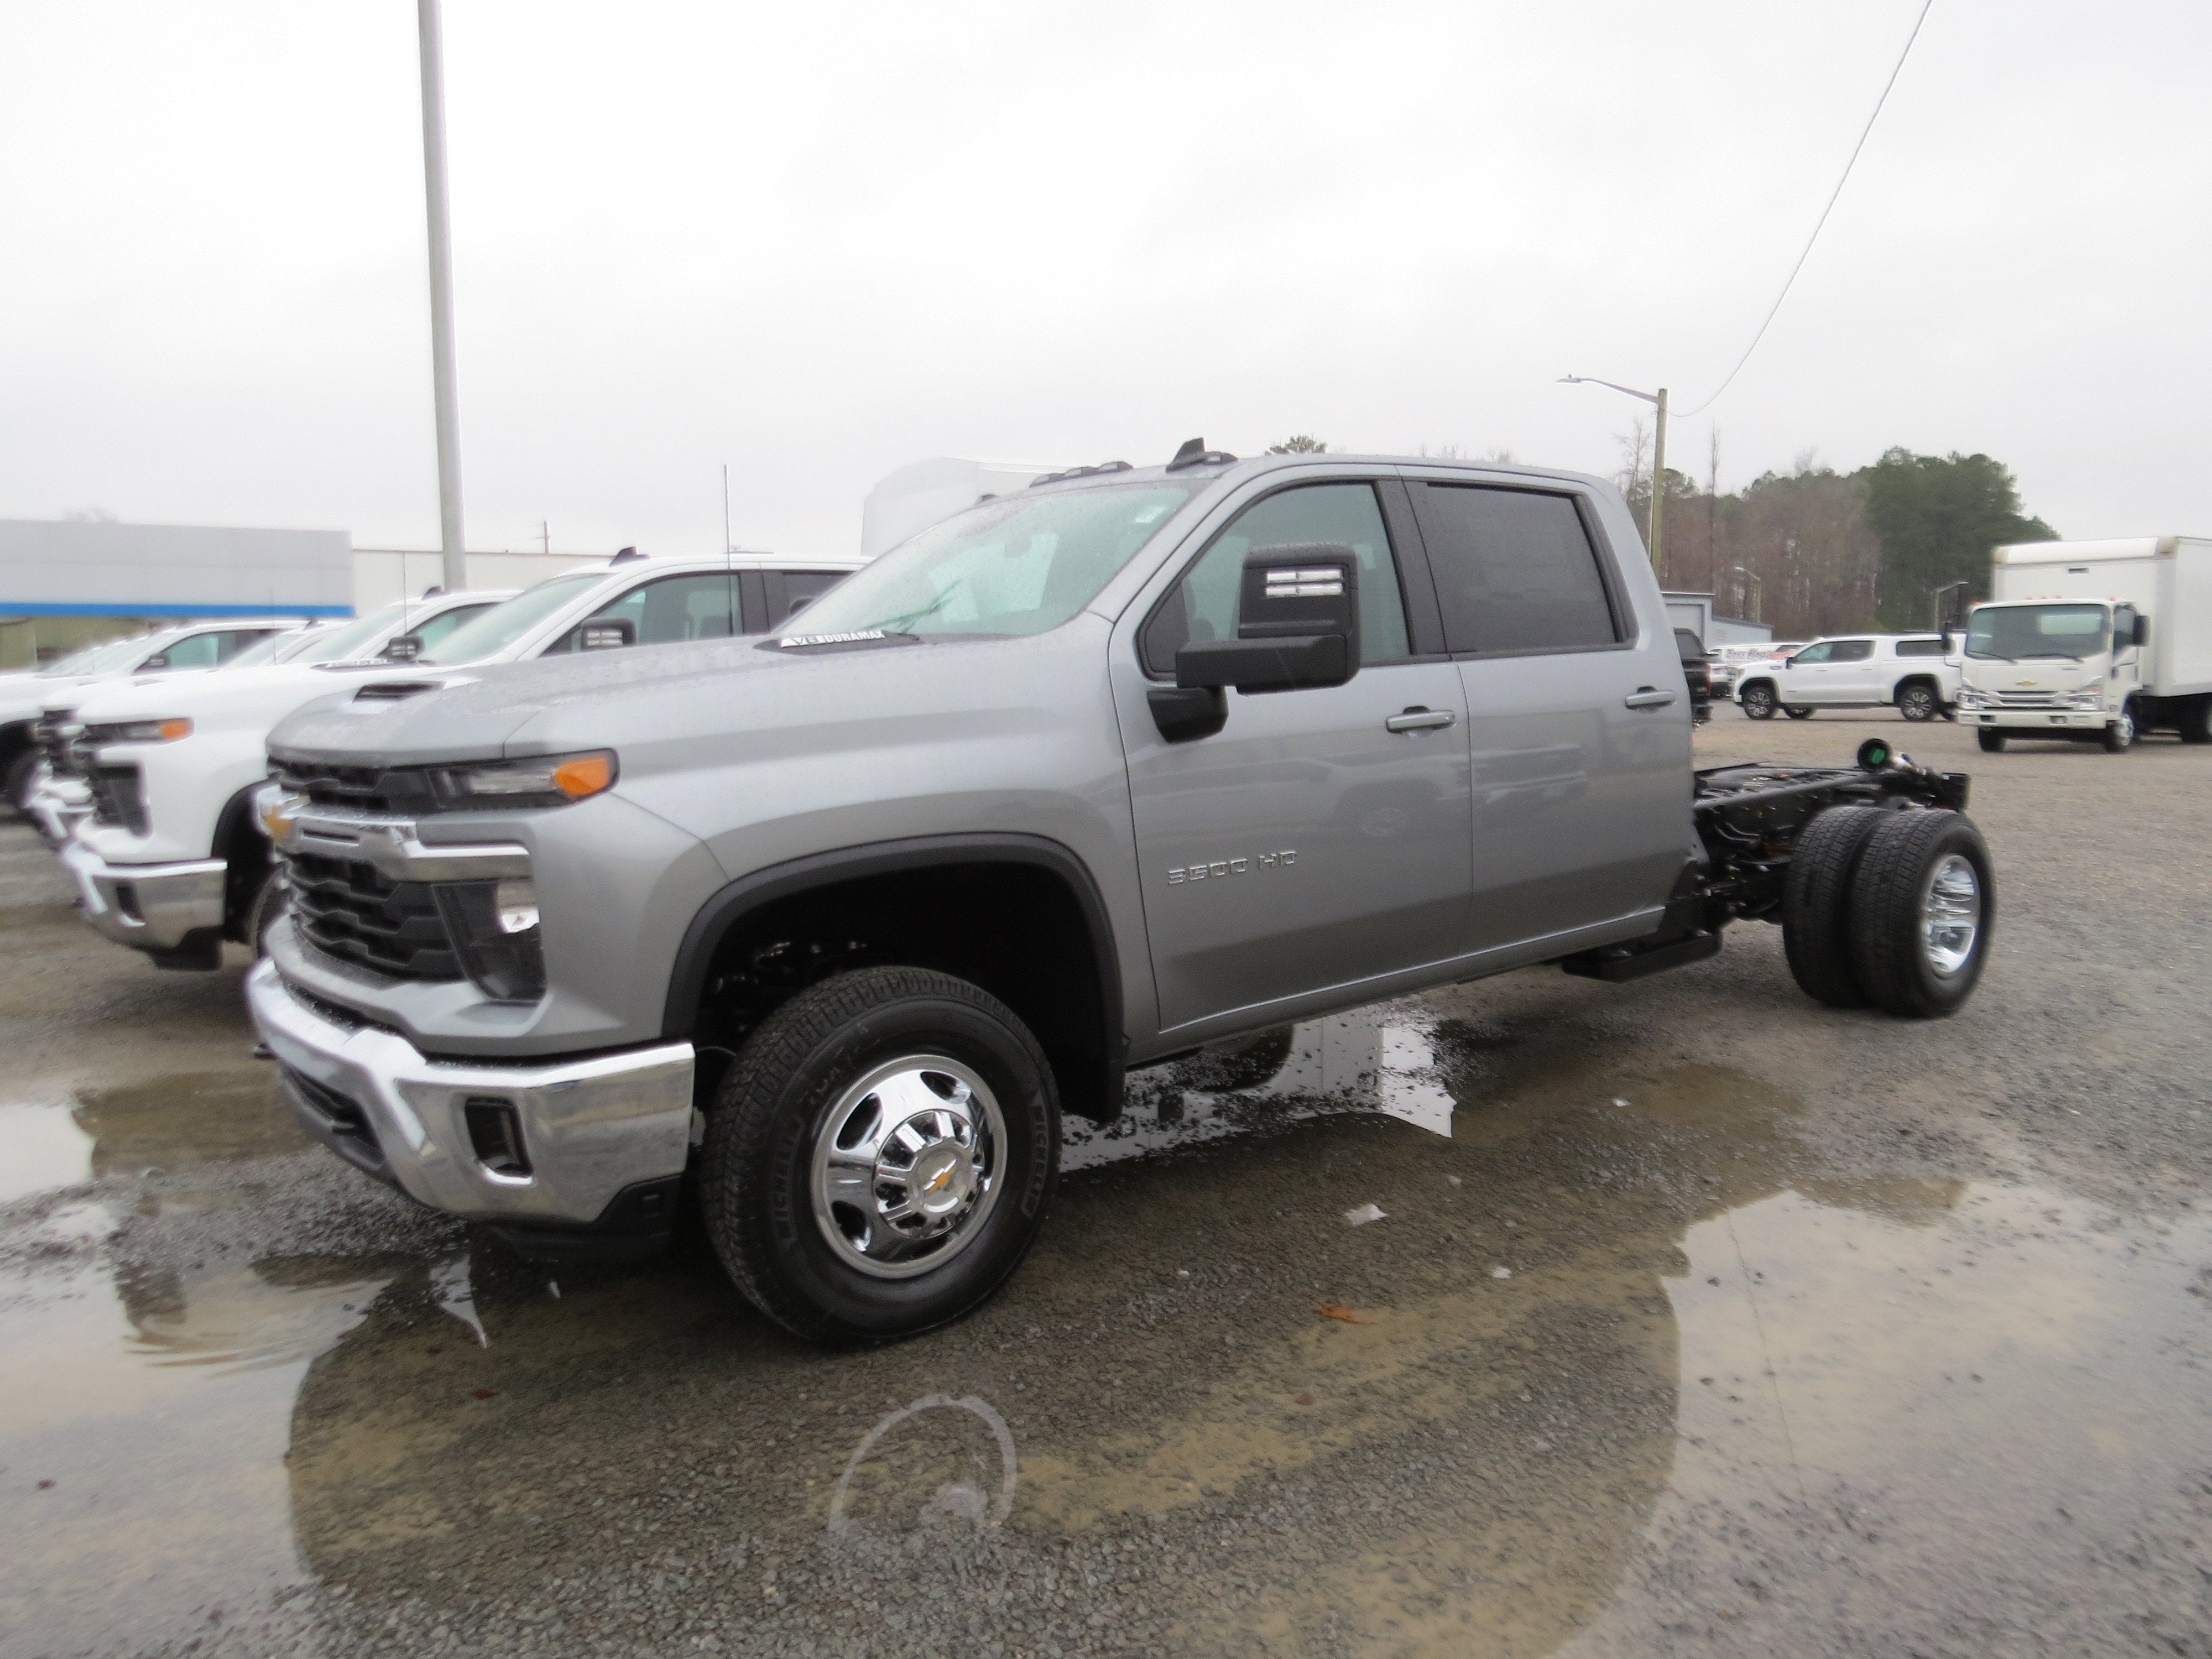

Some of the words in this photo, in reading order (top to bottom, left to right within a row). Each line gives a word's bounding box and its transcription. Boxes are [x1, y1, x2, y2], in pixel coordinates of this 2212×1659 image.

[824, 629, 886, 643] DURAMAX
[1167, 858, 1249, 885] 3500
[1258, 851, 1297, 870] HD
